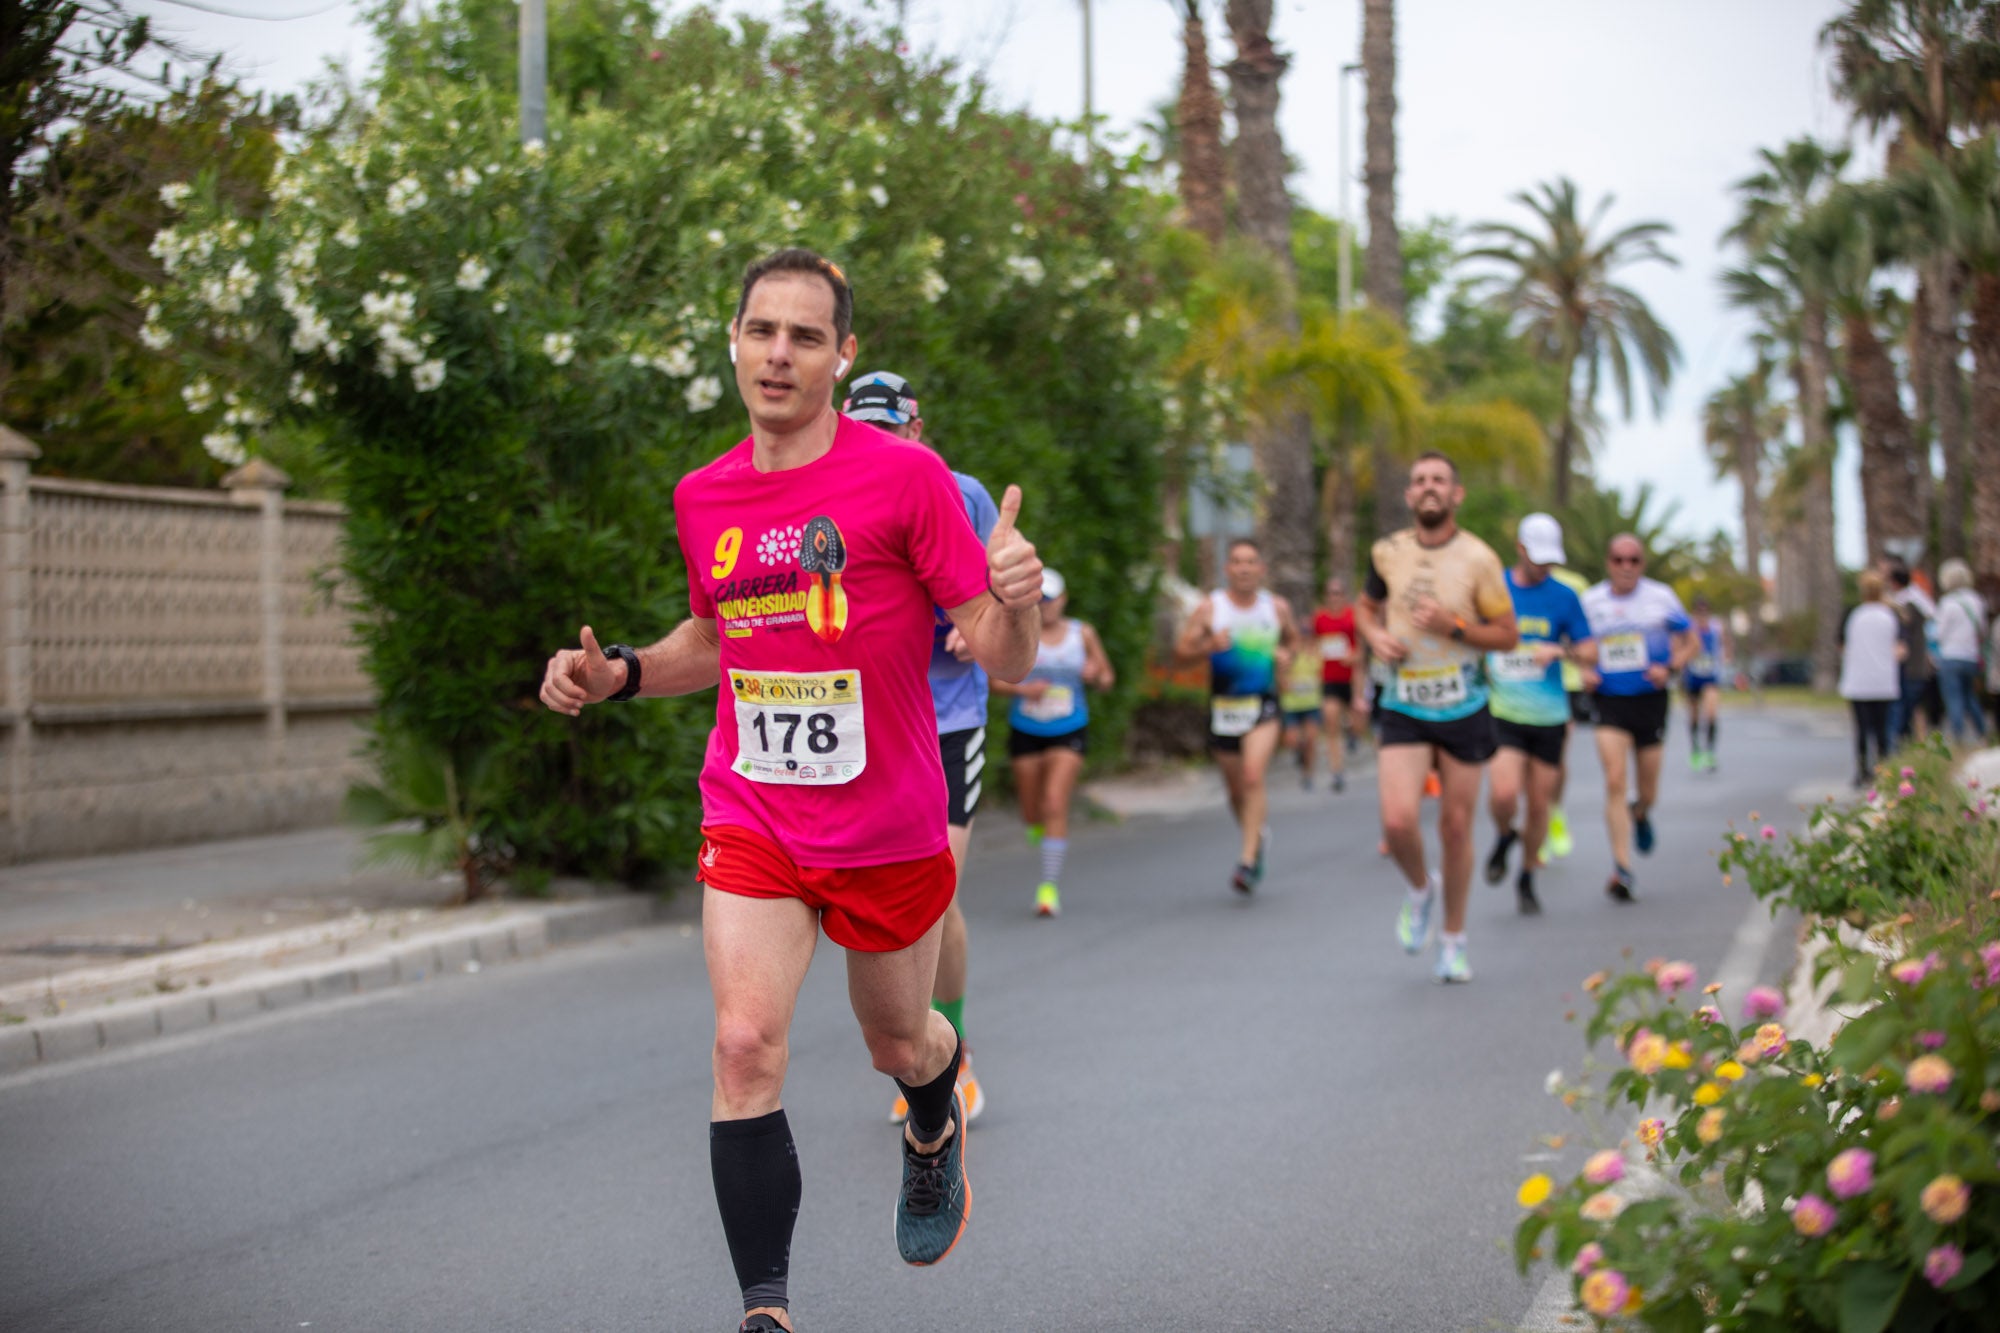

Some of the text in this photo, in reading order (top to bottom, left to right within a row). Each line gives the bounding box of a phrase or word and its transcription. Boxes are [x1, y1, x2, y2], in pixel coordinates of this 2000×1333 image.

[711, 527, 743, 579] 9
[715, 571, 798, 603] CARRERA
[718, 591, 807, 620] UNIVERSIDAD
[751, 618, 764, 627] DE
[745, 678, 760, 696] 38
[761, 685, 827, 699] FONDO
[1406, 679, 1459, 702] 1024
[753, 711, 839, 754] 178
